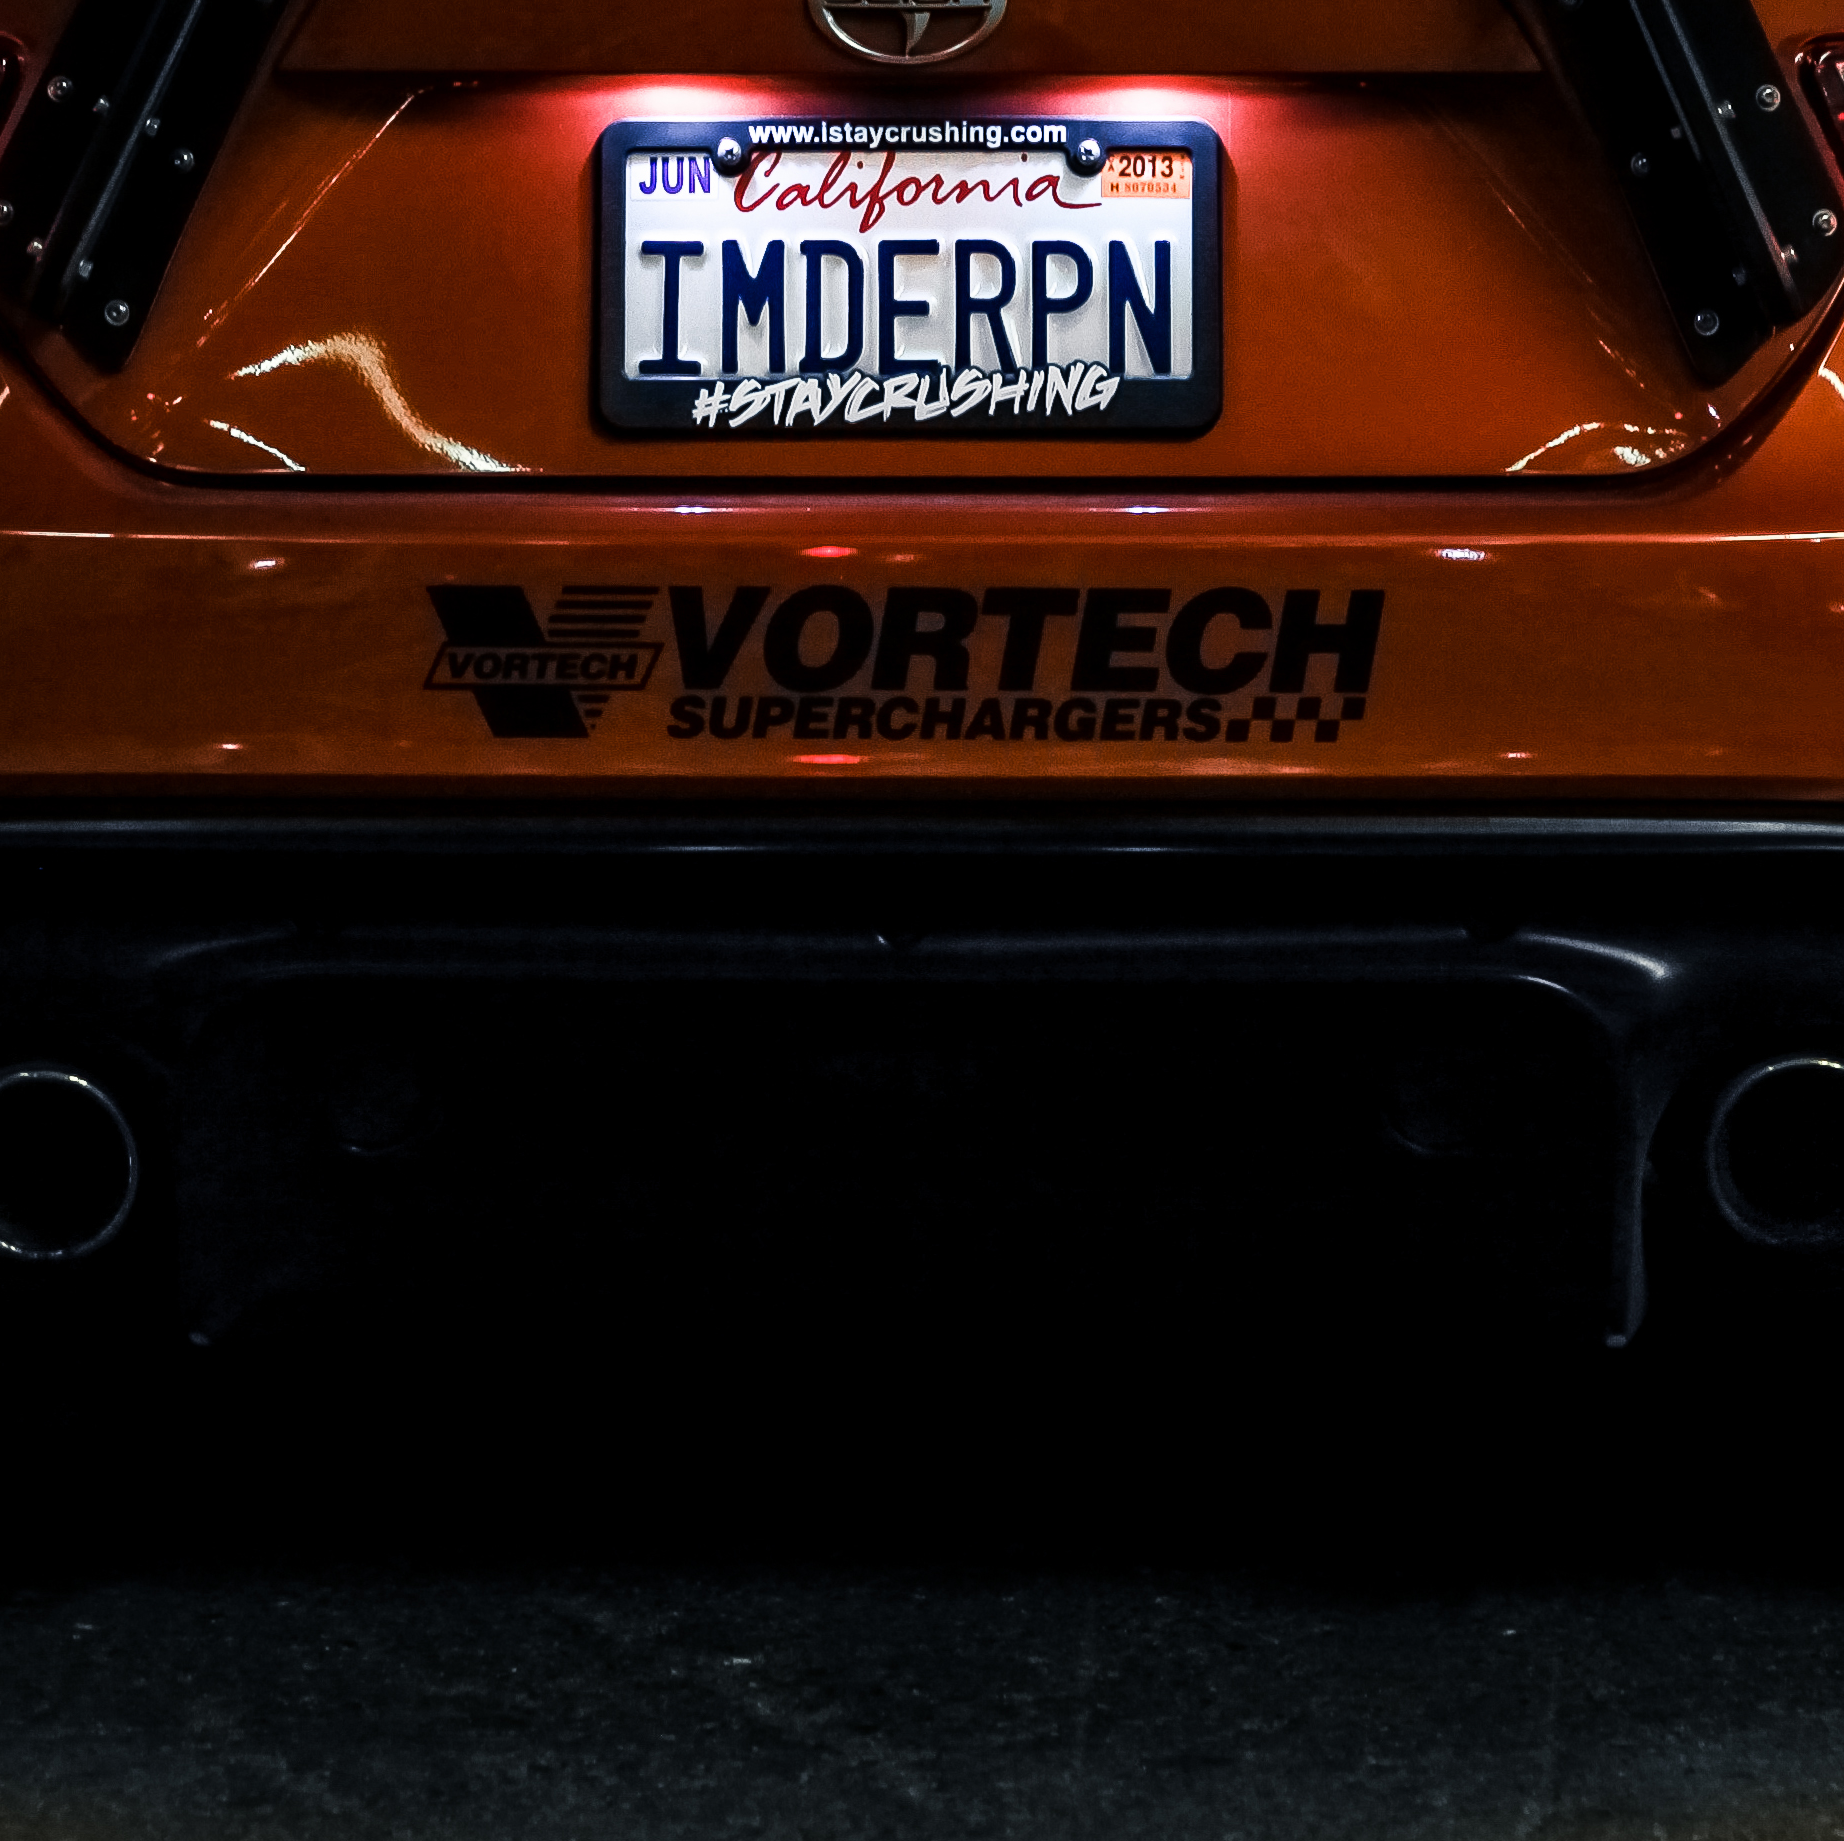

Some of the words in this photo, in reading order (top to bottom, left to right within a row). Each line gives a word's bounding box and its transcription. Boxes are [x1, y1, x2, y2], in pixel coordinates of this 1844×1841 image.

[748, 120, 1068, 149] www.istaycrushing.com
[639, 155, 711, 195] JUN
[1118, 155, 1174, 179] 2013
[733, 150, 1102, 234] California
[638, 239, 1172, 376] IMDERPN
[692, 361, 1120, 428] #STAYCRUSHING
[668, 586, 1385, 694] VORTECH
[445, 651, 639, 681] VORTECH
[667, 696, 1222, 741] SUPERCHARGERS
